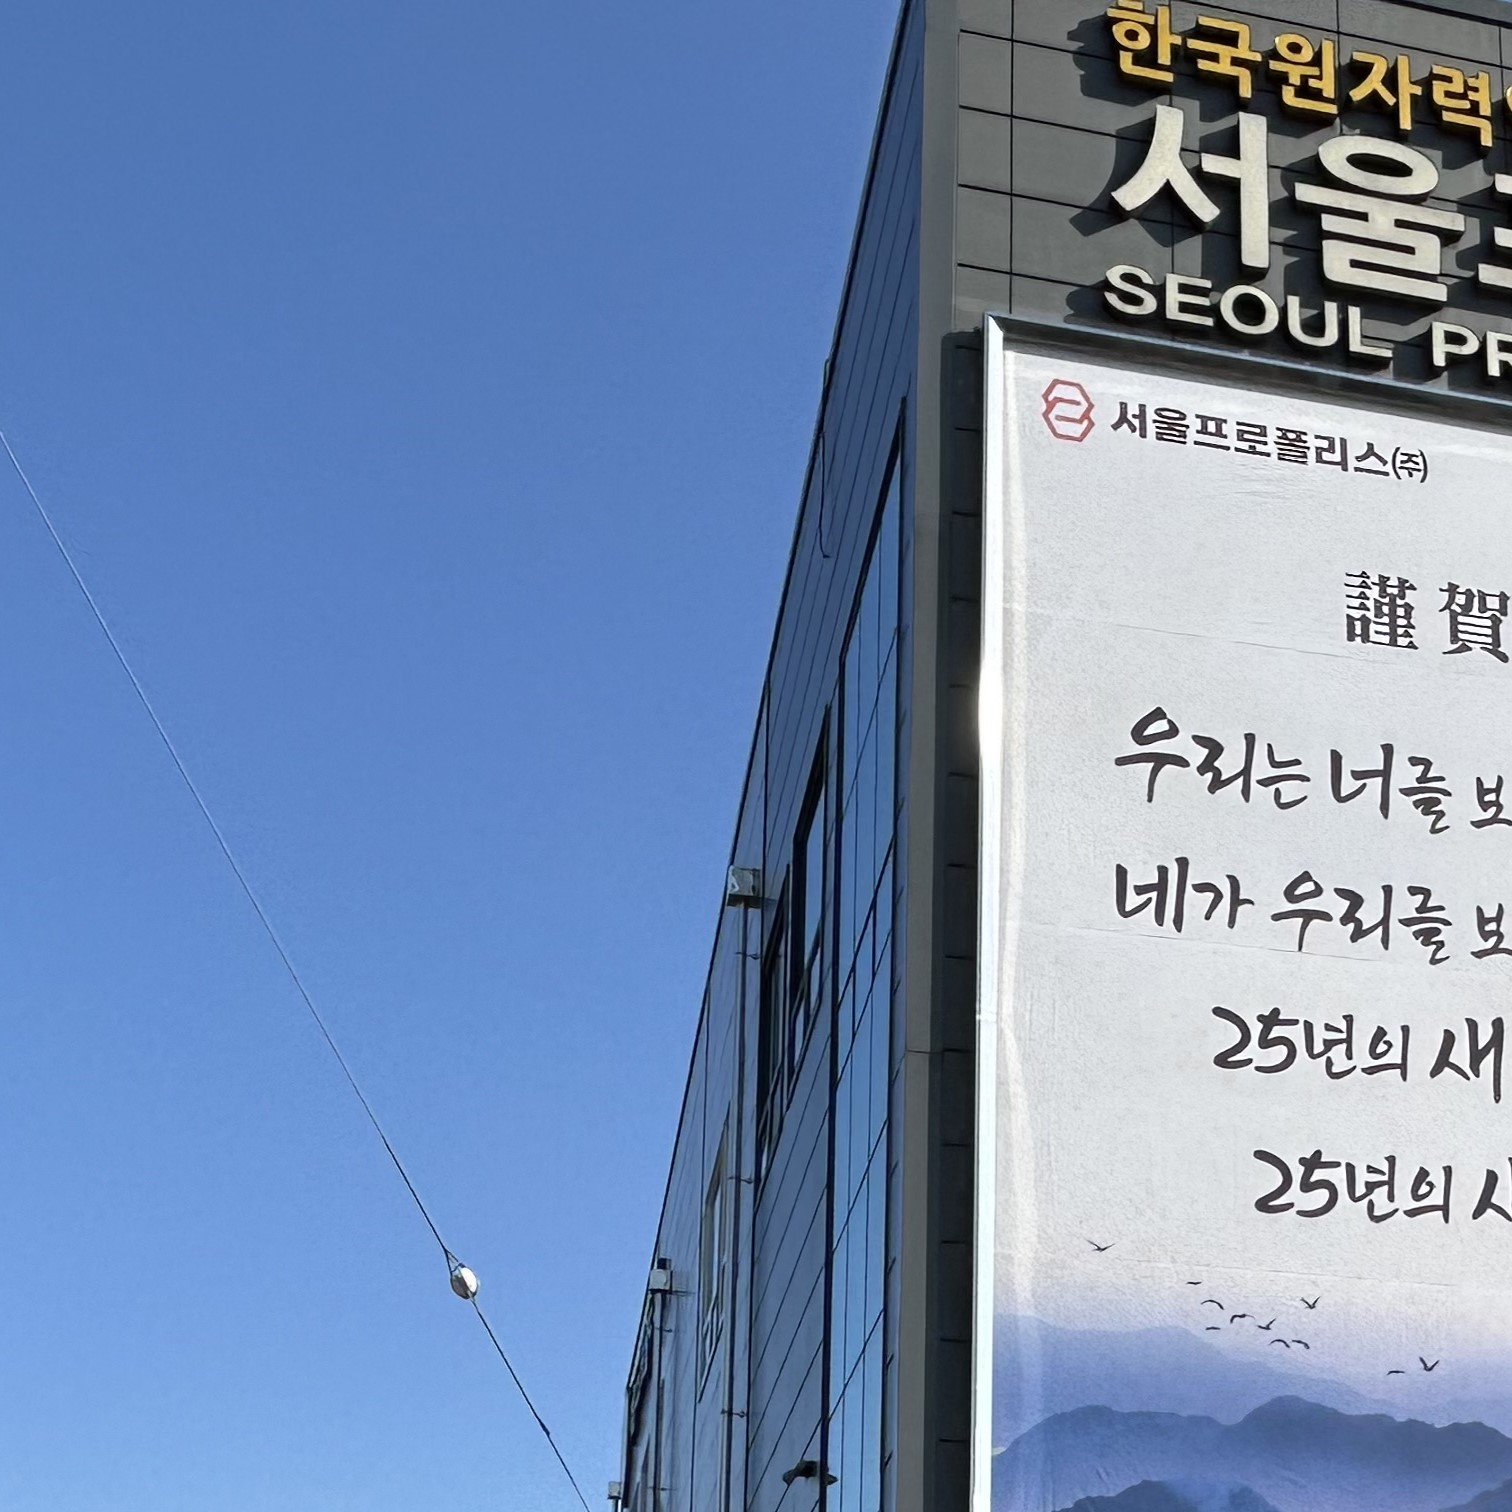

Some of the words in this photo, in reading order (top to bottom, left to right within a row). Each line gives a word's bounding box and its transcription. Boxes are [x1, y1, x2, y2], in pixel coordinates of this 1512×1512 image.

[1104, 264, 1395, 359] SEOUL
[1114, 706, 1311, 810] 우리는
[1329, 743, 1453, 836] 너를
[1114, 856, 1256, 934] 네가
[1270, 869, 1454, 967] 우리를
[1211, 1006, 1411, 1083] 25년의
[1428, 1016, 1506, 1105] 새
[1252, 1148, 1454, 1225] 25년의
